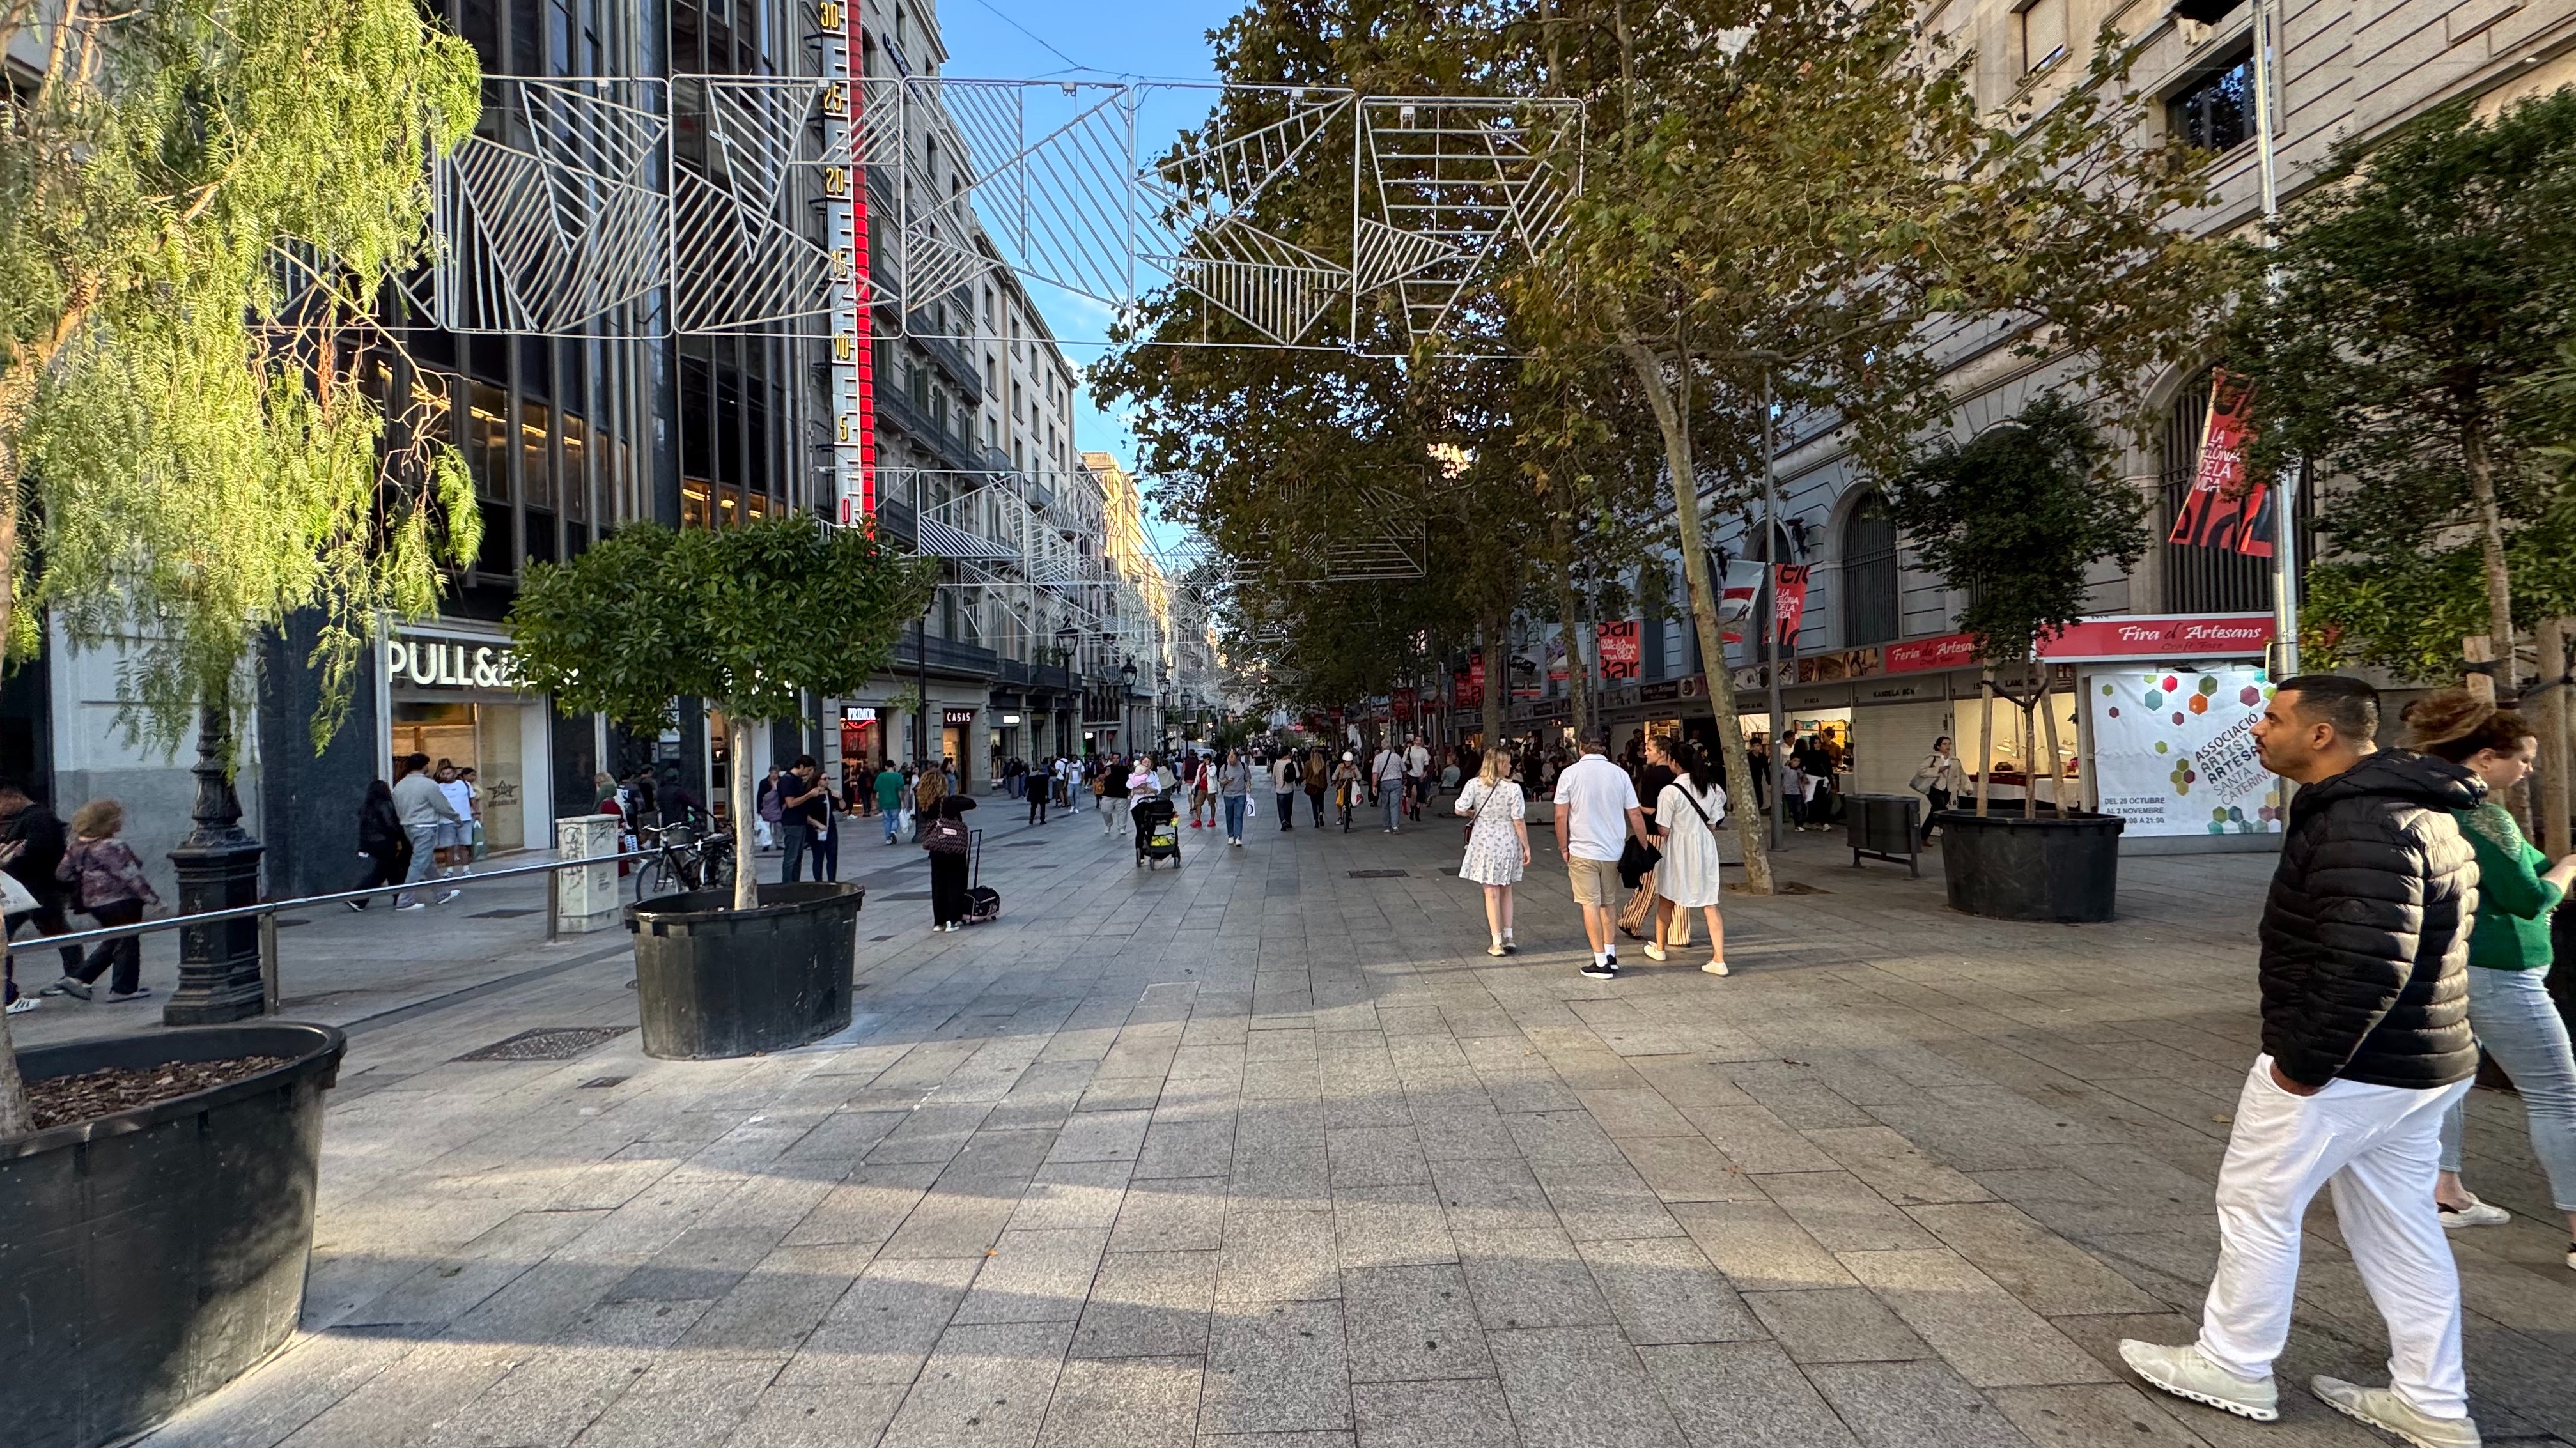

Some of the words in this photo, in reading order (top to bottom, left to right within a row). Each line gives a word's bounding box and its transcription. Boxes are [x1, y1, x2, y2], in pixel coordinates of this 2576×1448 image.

[820, 2, 839, 28] 30
[824, 86, 842, 111] 25
[826, 168, 844, 194] 20
[831, 250, 846, 276] 15
[835, 333, 850, 360] 10
[839, 415, 848, 441] 5
[2118, 626, 2160, 641] Fira
[1892, 647, 1920, 661] Feria
[1921, 642, 1934, 656] de
[847, 708, 876, 720] PRIMOR
[947, 712, 970, 723] CASAS
[2195, 711, 2258, 762] ASSOCIACIÓ
[2214, 767, 2253, 796] SANTA
